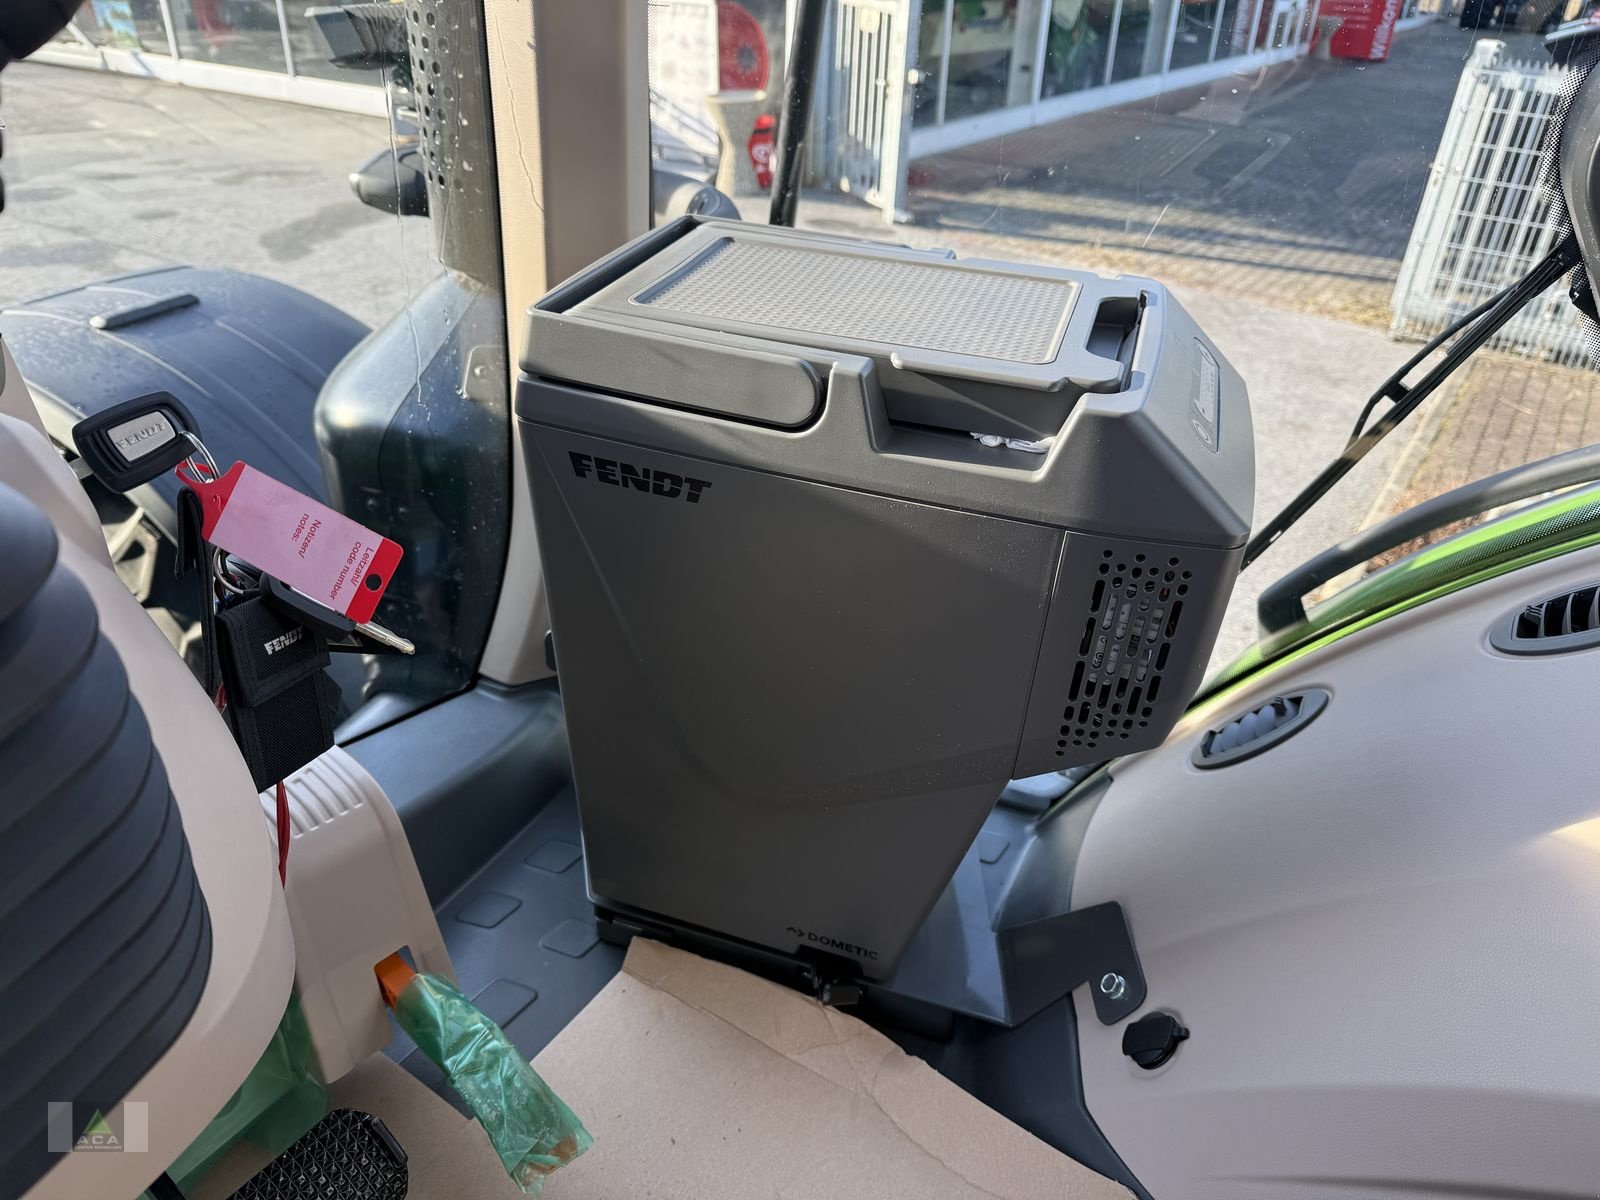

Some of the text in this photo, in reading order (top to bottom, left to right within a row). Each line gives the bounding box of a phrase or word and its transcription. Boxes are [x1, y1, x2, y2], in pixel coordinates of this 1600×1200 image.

[115, 420, 166, 450] FENDT
[568, 450, 713, 504] FENDT
[291, 513, 310, 542] notes:
[298, 519, 322, 559] Notizen/
[329, 541, 362, 600] code number
[351, 546, 374, 587] Leitzahl/
[807, 931, 878, 960] DOMETIC
